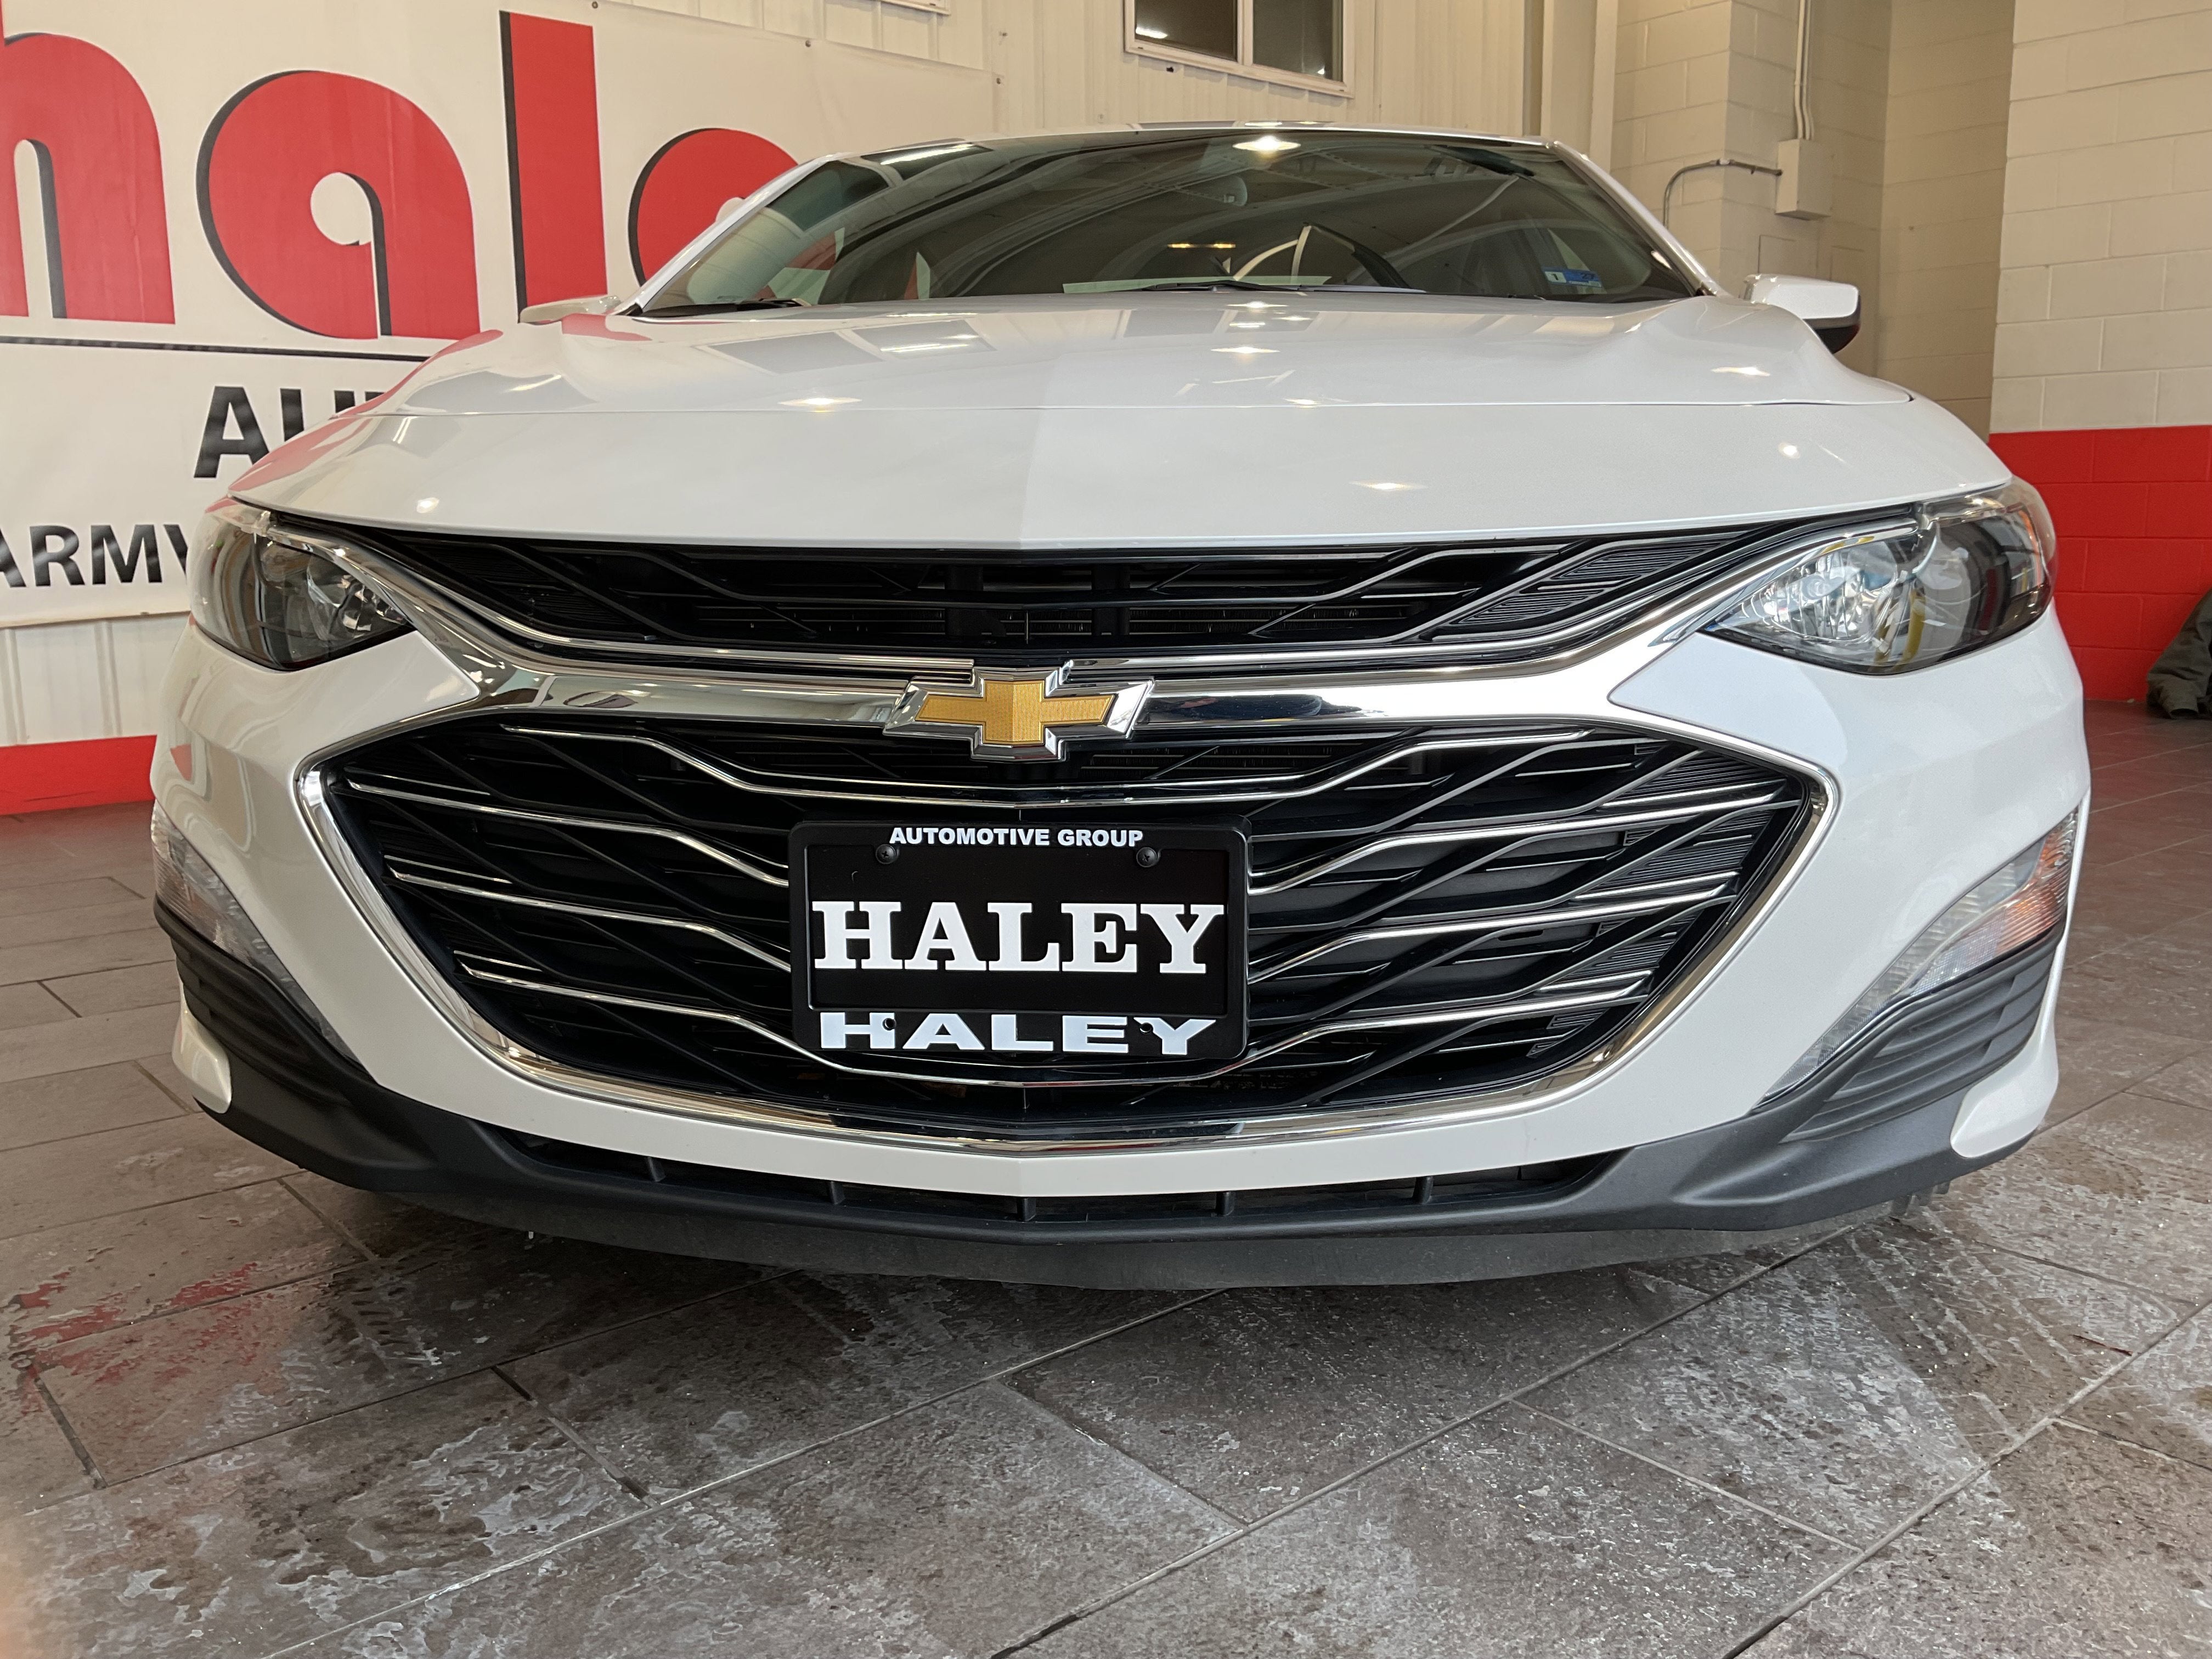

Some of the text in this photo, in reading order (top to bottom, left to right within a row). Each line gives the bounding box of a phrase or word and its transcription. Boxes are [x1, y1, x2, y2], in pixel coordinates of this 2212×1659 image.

[889, 827, 1143, 848] AUTOMOTIVE GROUP
[812, 900, 1224, 974] HALEY
[820, 1012, 1216, 1055] HALEY
